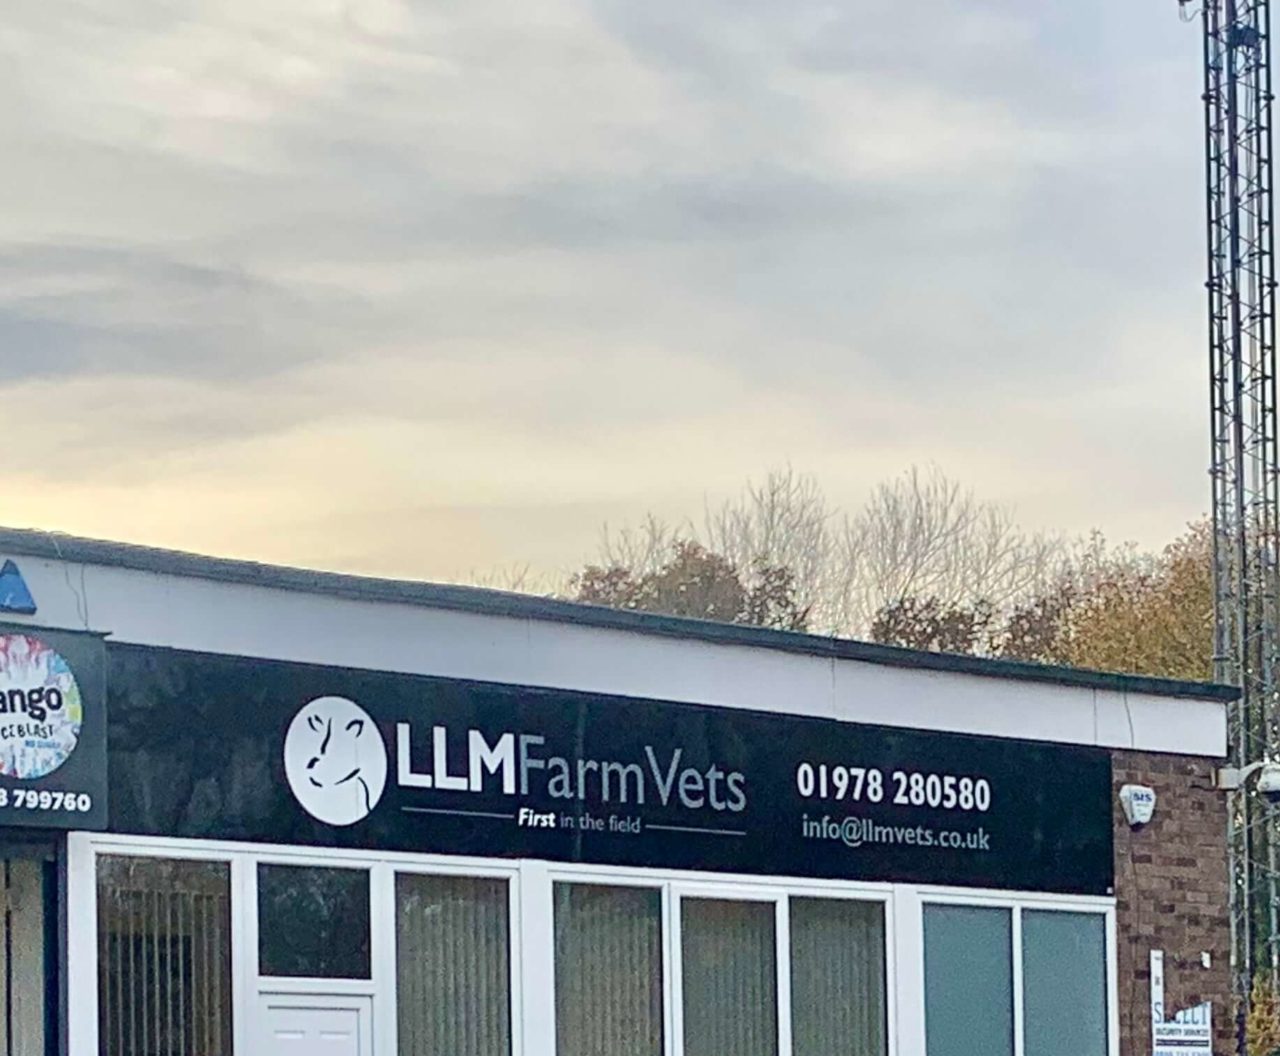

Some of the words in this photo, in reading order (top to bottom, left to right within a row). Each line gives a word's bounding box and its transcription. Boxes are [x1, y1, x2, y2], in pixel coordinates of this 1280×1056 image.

[12, 788, 91, 812] 799760
[797, 762, 884, 803] 01978
[892, 771, 991, 812] 280580
[518, 807, 556, 828] First
[560, 811, 574, 829] in
[580, 812, 605, 831] the
[608, 814, 641, 834] field
[802, 813, 990, 850] info@llmvets.co.uk
